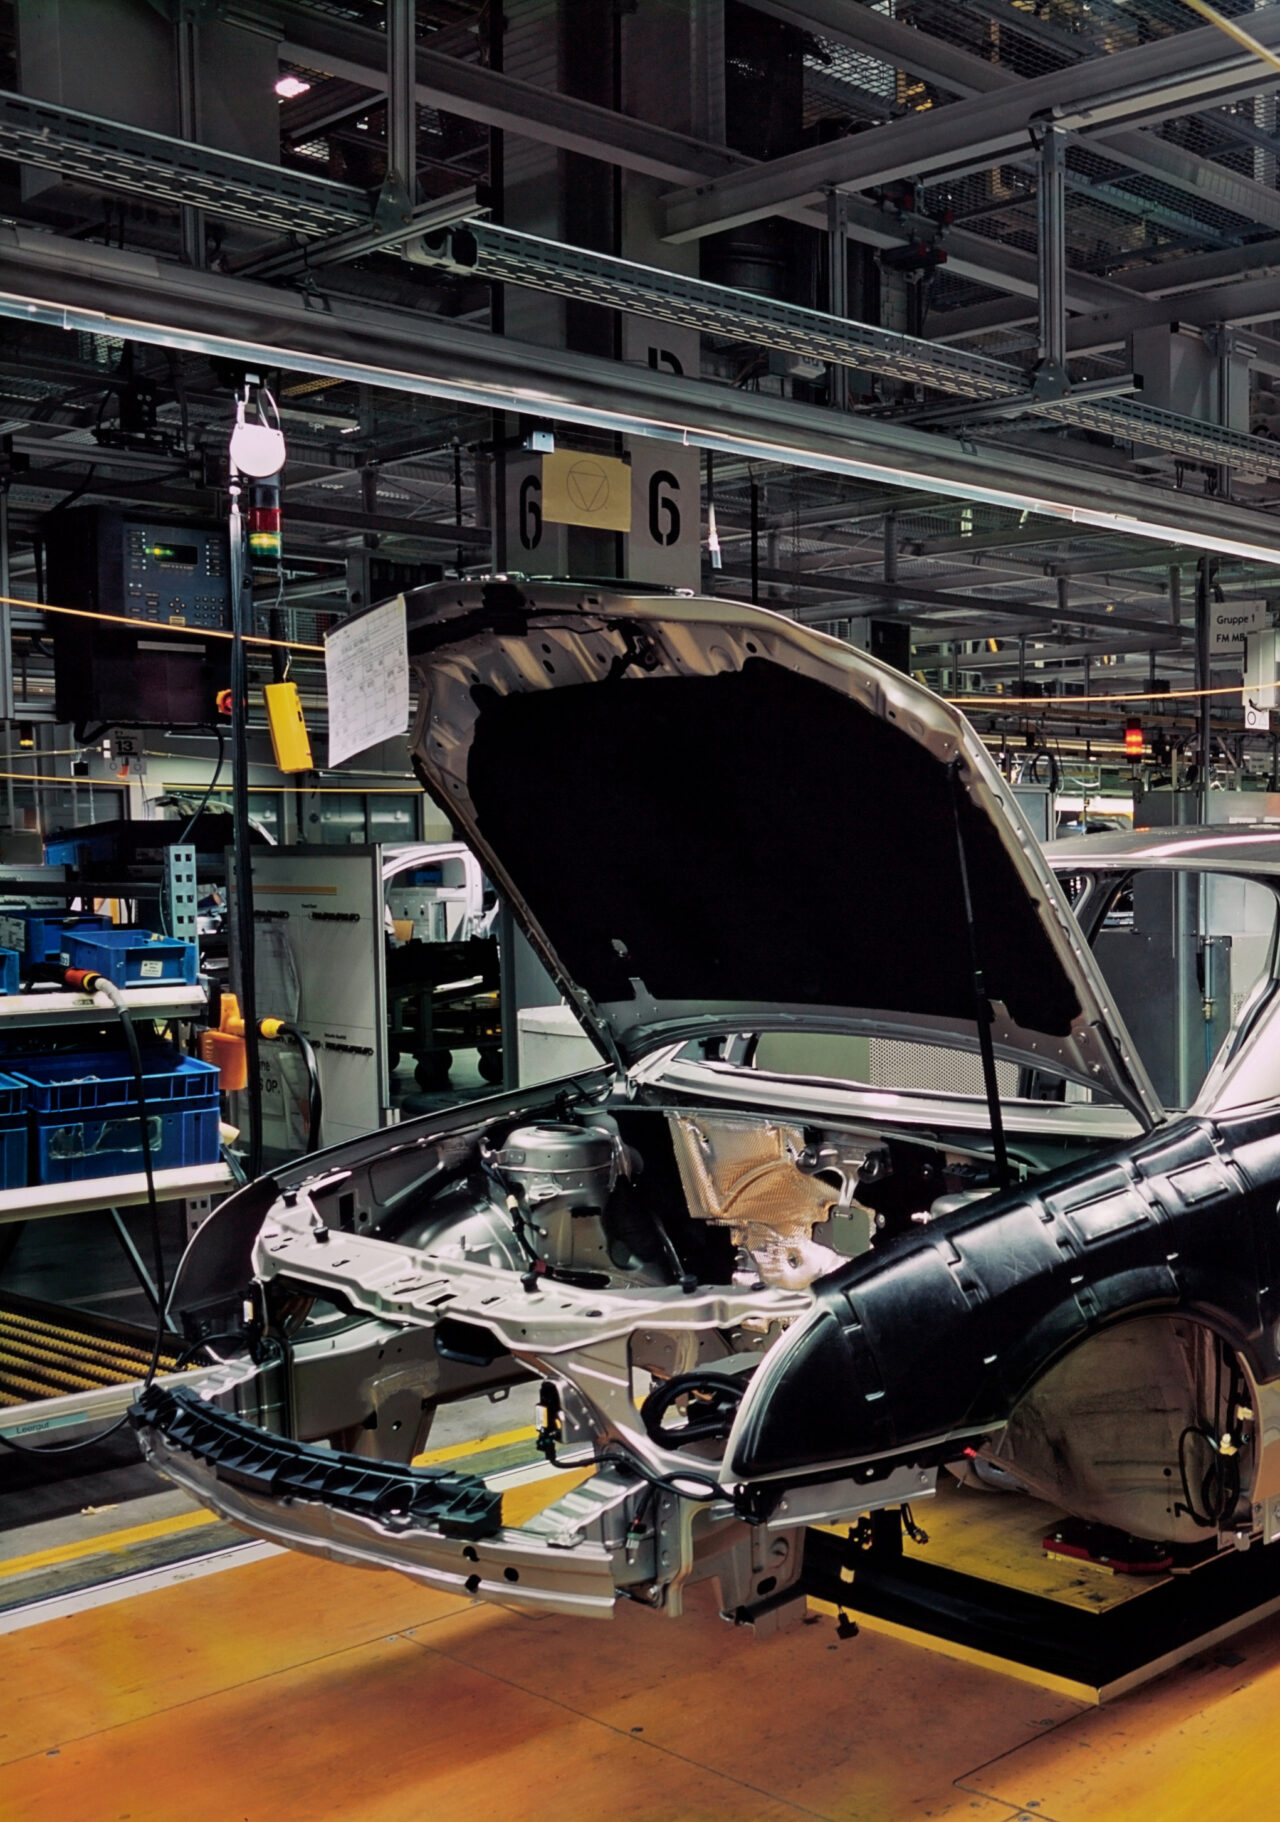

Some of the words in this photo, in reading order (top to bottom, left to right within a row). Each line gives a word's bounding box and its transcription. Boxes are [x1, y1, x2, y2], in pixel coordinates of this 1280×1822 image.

[519, 474, 542, 550] 6
[649, 470, 681, 546] 6
[1216, 615, 1249, 626] Gruppe
[1251, 613, 1255, 623] 1
[1216, 633, 1230, 642] FM
[115, 740, 133, 752] 13
